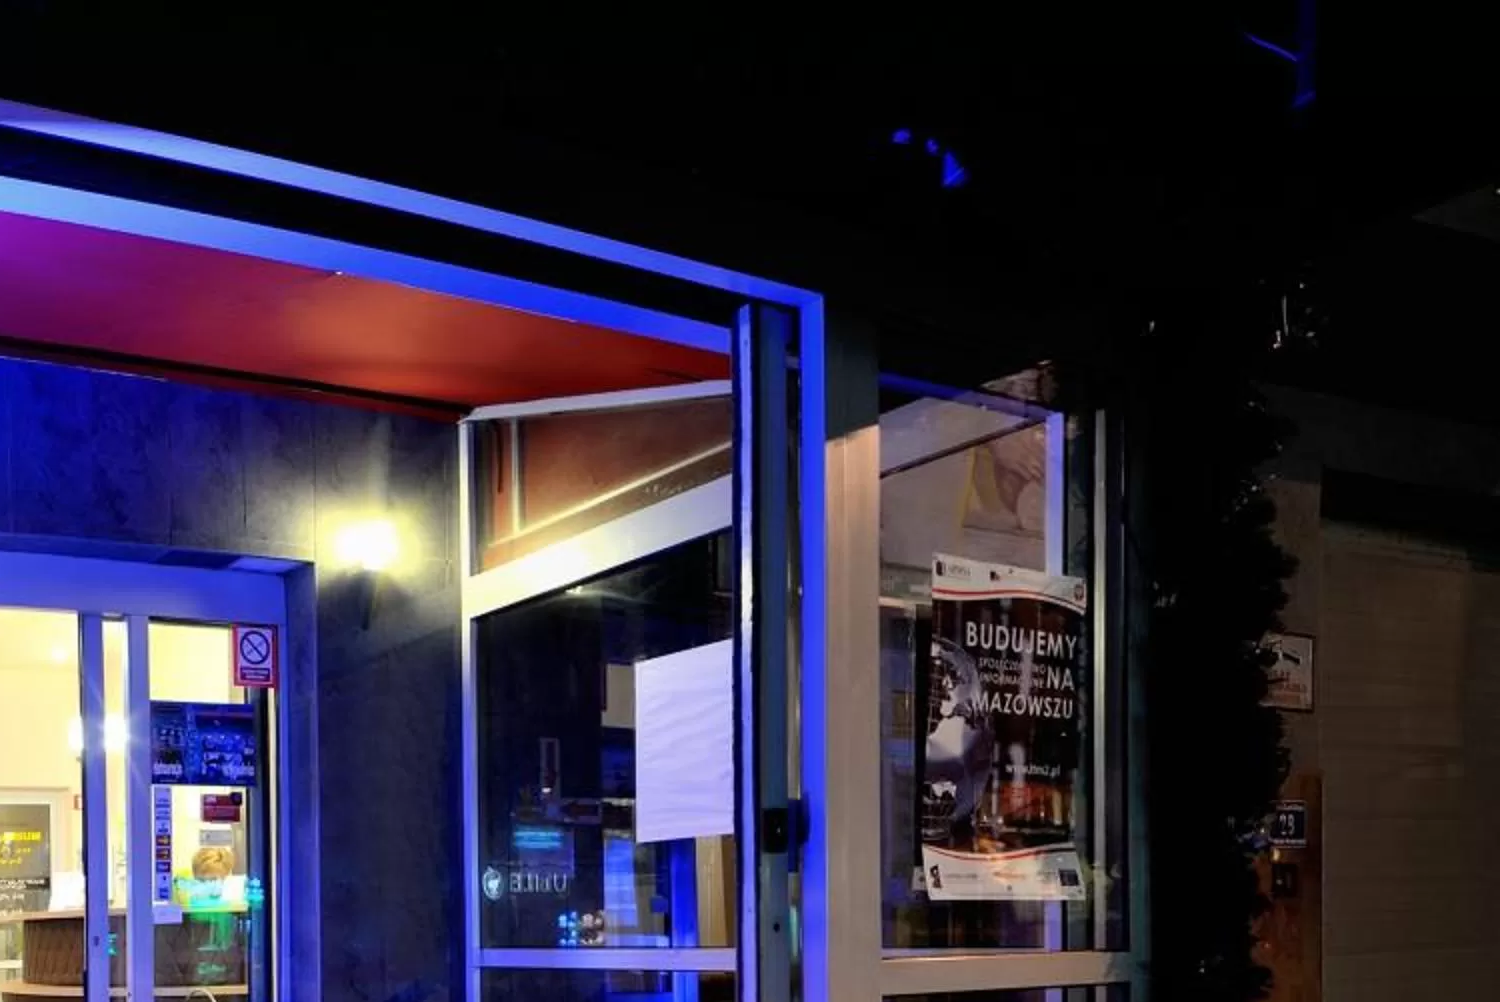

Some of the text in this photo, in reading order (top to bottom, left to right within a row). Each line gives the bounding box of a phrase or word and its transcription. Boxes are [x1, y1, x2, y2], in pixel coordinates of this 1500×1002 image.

[965, 621, 1078, 661] BUDUJEMY
[1047, 667, 1075, 691] NA
[971, 692, 1074, 719] MAZOWSZU
